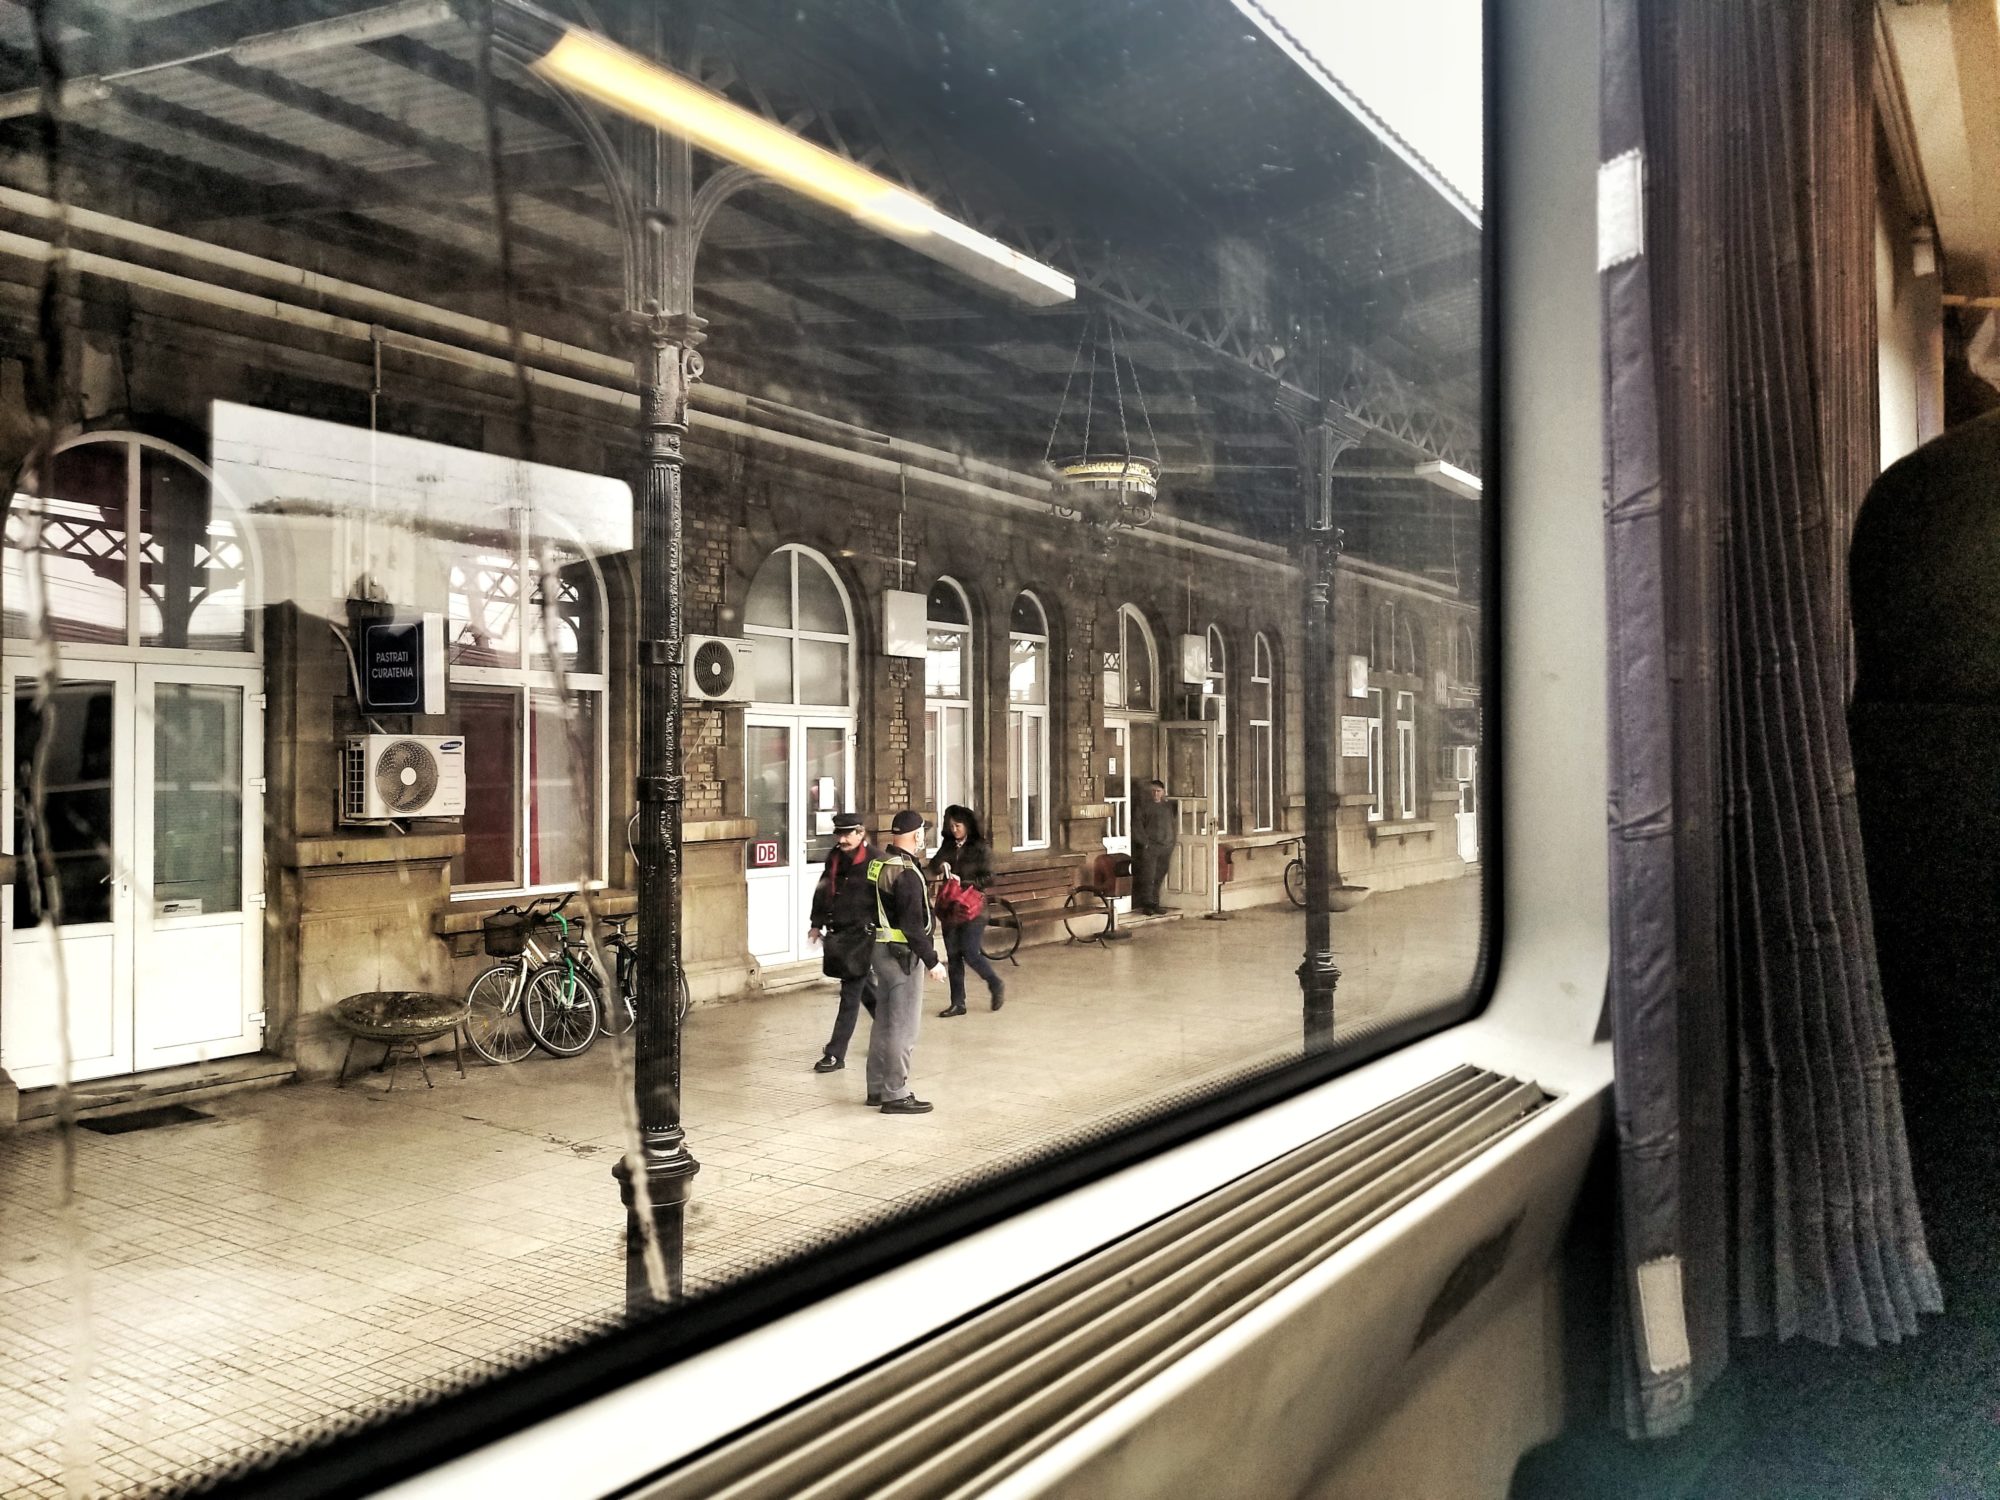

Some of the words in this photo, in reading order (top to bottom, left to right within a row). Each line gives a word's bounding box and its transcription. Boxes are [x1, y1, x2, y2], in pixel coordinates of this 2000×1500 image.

[376, 651, 409, 663] PASTRATI
[371, 667, 414, 679] CURATENIA
[758, 845, 776, 862] DB
